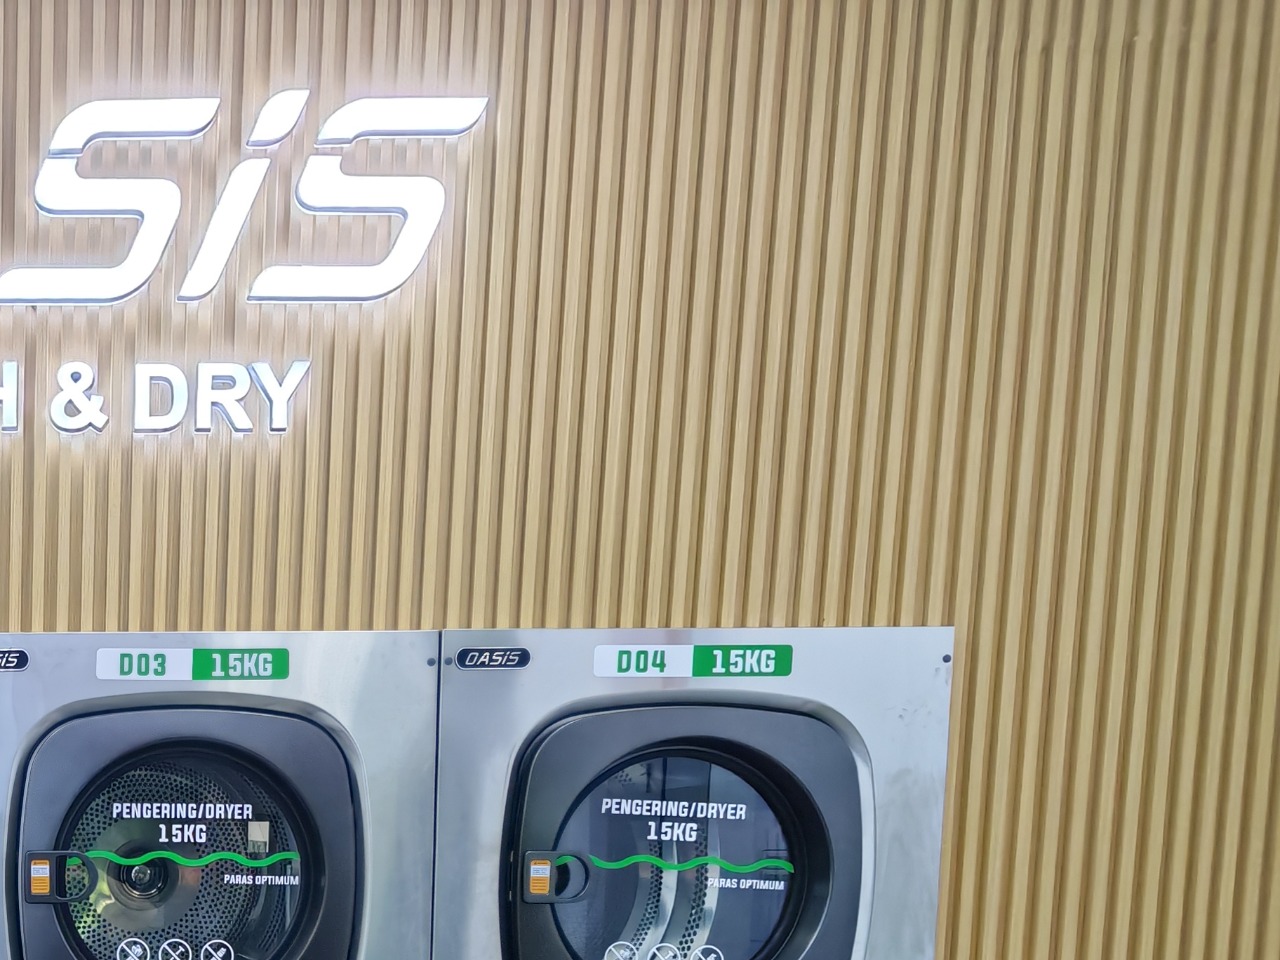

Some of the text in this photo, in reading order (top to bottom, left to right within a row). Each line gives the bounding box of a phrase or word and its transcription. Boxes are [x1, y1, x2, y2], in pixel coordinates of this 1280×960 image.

[51, 360, 109, 432] &
[134, 359, 311, 433] DRY
[119, 652, 273, 677] D03 15KG
[617, 650, 776, 674] D04 15KG
[112, 803, 253, 821] PENGERING/DRYER
[601, 798, 747, 820] PENGERING/DRYER
[158, 824, 207, 843] 15KG
[646, 821, 698, 842] 15KG
[224, 874, 299, 886] PARAS OPTIMUM
[707, 877, 785, 890] PARAS OPTIMUM
